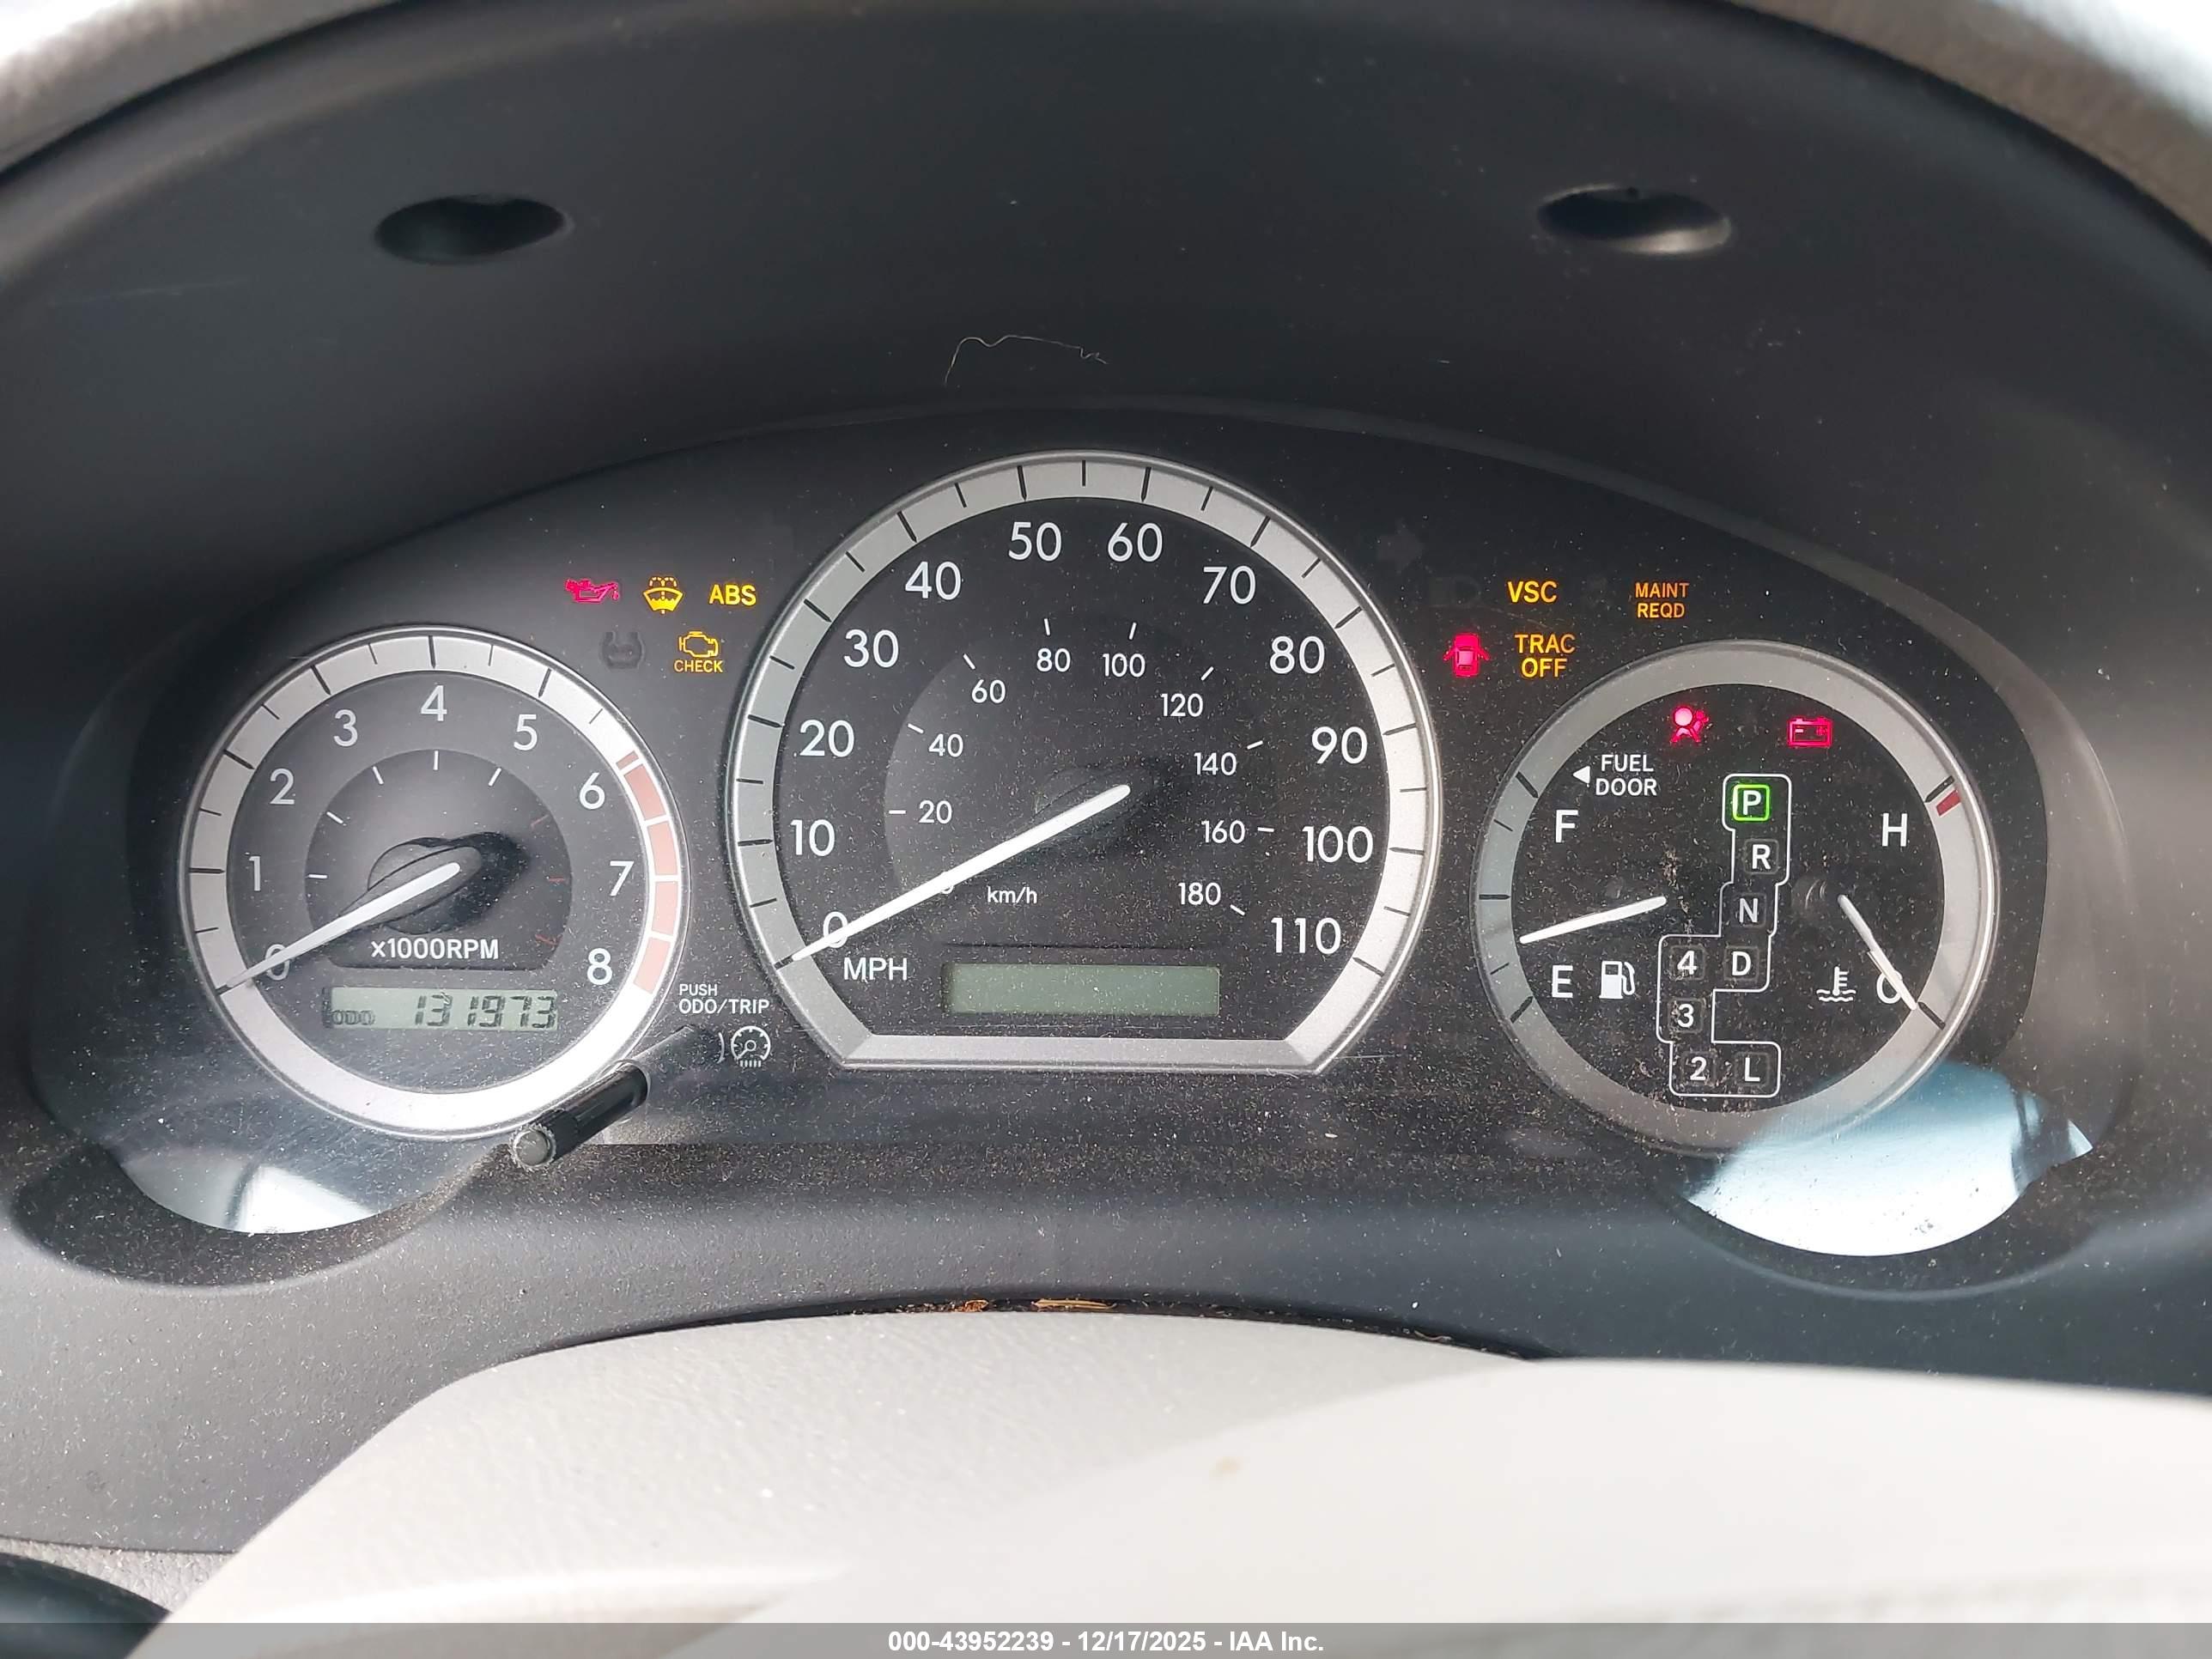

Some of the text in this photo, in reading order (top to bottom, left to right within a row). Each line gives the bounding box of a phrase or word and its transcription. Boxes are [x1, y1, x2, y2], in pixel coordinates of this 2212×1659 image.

[1008, 521, 1062, 562] 50
[1108, 522, 1163, 562] 60
[905, 561, 961, 600] 40
[1203, 565, 1256, 605] 70
[1507, 580, 1557, 603] VSC
[1635, 582, 1689, 599] MAINT
[708, 584, 757, 606] ABS
[1637, 602, 1685, 618] REQD
[843, 629, 899, 668] 30
[1269, 635, 1325, 674] 80
[1514, 634, 1575, 654] TRAC
[674, 659, 723, 673] CHECK
[1036, 647, 1071, 672] 80
[1102, 653, 1146, 678] 100
[1521, 657, 1568, 678] OFF
[420, 684, 447, 722] 4
[971, 678, 1006, 704] 60
[1160, 693, 1204, 717] 120
[333, 709, 358, 747] 3
[514, 714, 538, 751] 5
[799, 719, 854, 757] 20
[928, 733, 963, 757] 40
[1311, 726, 1368, 764] 90
[1194, 751, 1237, 776] 140
[1601, 753, 1654, 772] FUEL
[270, 768, 295, 805] 2
[579, 772, 605, 810] 6
[1595, 777, 1657, 796] DOOR
[918, 799, 952, 824] 20
[1743, 790, 1762, 816] P
[790, 818, 836, 857] 10
[1200, 819, 1246, 844] 160
[1555, 809, 1579, 843] F
[1881, 812, 1908, 848] H
[1302, 825, 1374, 863] 100
[1752, 843, 1771, 870] R
[248, 855, 261, 891] 1
[610, 860, 635, 896] 7
[986, 884, 1037, 904] km/h
[1178, 882, 1221, 906] 180
[1739, 897, 1759, 923] N
[822, 911, 848, 949] 0
[1270, 917, 1341, 955] 110
[371, 937, 499, 960] x1000RPM
[264, 943, 290, 981] 0
[586, 947, 613, 986] 8
[843, 957, 908, 983] MPH
[1677, 950, 1698, 975] 4
[1731, 951, 1752, 976] D
[678, 983, 718, 997] PUSH
[1551, 964, 1574, 999] E
[414, 994, 556, 1029] 131973
[678, 998, 770, 1015] ODO/TRIP
[1677, 1003, 1694, 1028] 3
[1690, 1056, 1707, 1081] 2
[1744, 1056, 1760, 1082] L
